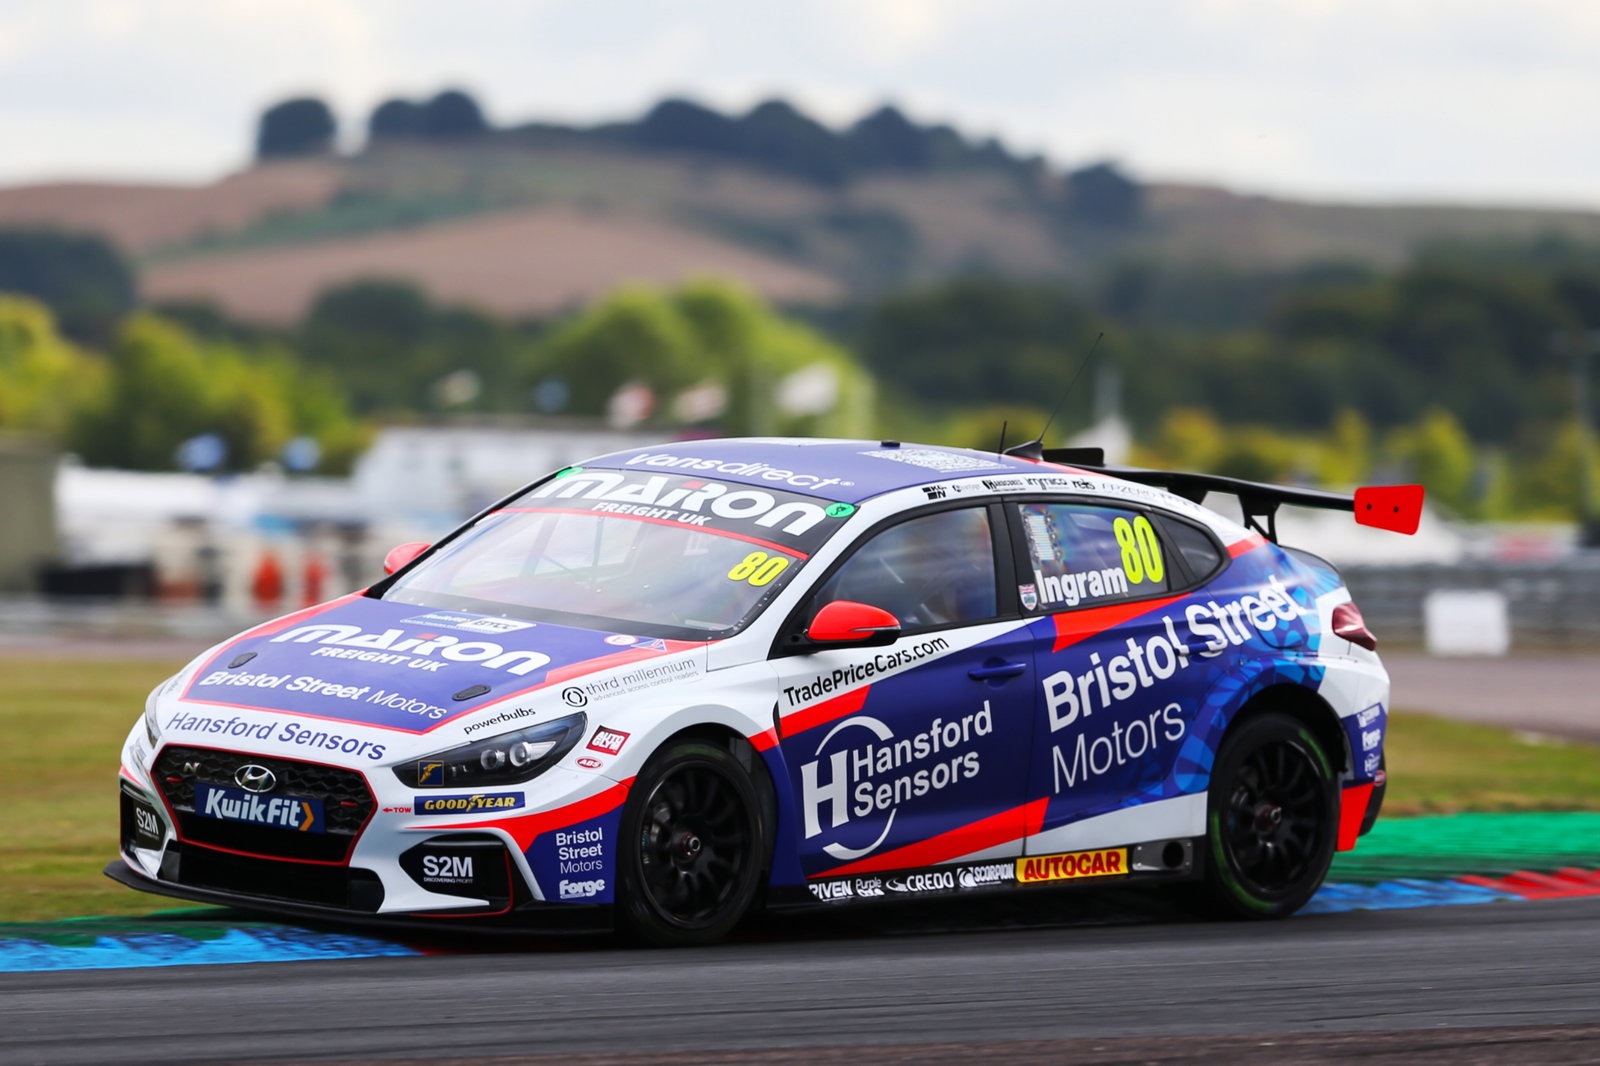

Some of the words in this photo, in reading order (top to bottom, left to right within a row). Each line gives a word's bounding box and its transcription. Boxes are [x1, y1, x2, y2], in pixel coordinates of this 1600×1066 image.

[592, 502, 678, 520] FREIGHT
[678, 513, 712, 526] UK
[1113, 515, 1164, 585] 80
[727, 551, 789, 587] 80
[1034, 567, 1128, 607] Ingram
[310, 646, 412, 665] FREIGHT
[407, 658, 449, 673] UK
[1041, 616, 1190, 734] Bristol
[1184, 574, 1306, 657] Street
[586, 676, 620, 696] third
[622, 657, 697, 685] millennium
[783, 636, 950, 707] TradePriceCars.com
[199, 671, 292, 689] Bristol
[285, 676, 372, 701] Street
[365, 689, 448, 720] Motors
[463, 705, 536, 735] powerbulbs
[164, 711, 279, 740] Hansford
[278, 722, 387, 761] Sensors
[852, 699, 994, 782] Hansford
[1051, 702, 1187, 794] Motors
[800, 749, 851, 840] H
[853, 750, 981, 818] Sensors
[393, 806, 412, 814] TOW
[424, 796, 516, 812] GOODYEAR
[135, 807, 160, 836] S2M
[556, 827, 603, 846] Bristol
[423, 855, 473, 878] S2M
[558, 843, 603, 861] Street
[1024, 853, 1121, 880] AUTOCAR
[560, 860, 603, 875] Motors
[906, 871, 955, 892] CREDO
[974, 862, 1015, 882] SCORPION
